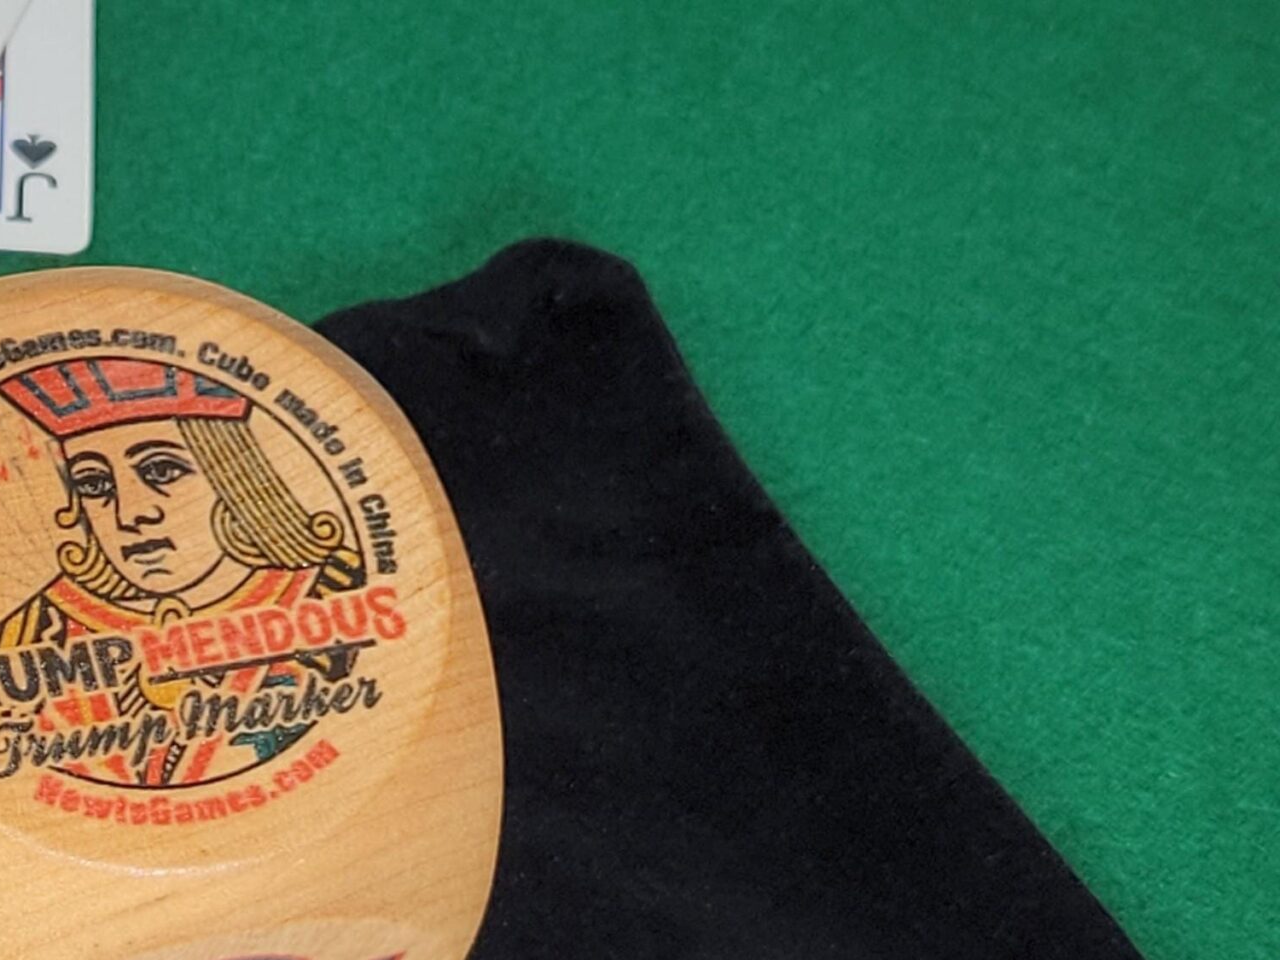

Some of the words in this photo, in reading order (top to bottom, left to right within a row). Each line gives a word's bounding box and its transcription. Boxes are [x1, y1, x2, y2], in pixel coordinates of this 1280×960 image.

[6, 172, 58, 222] J
[197, 341, 271, 392] Cube
[273, 388, 346, 456] made
[338, 457, 368, 489] in
[358, 493, 399, 575] China
[179, 672, 383, 741] Marker
